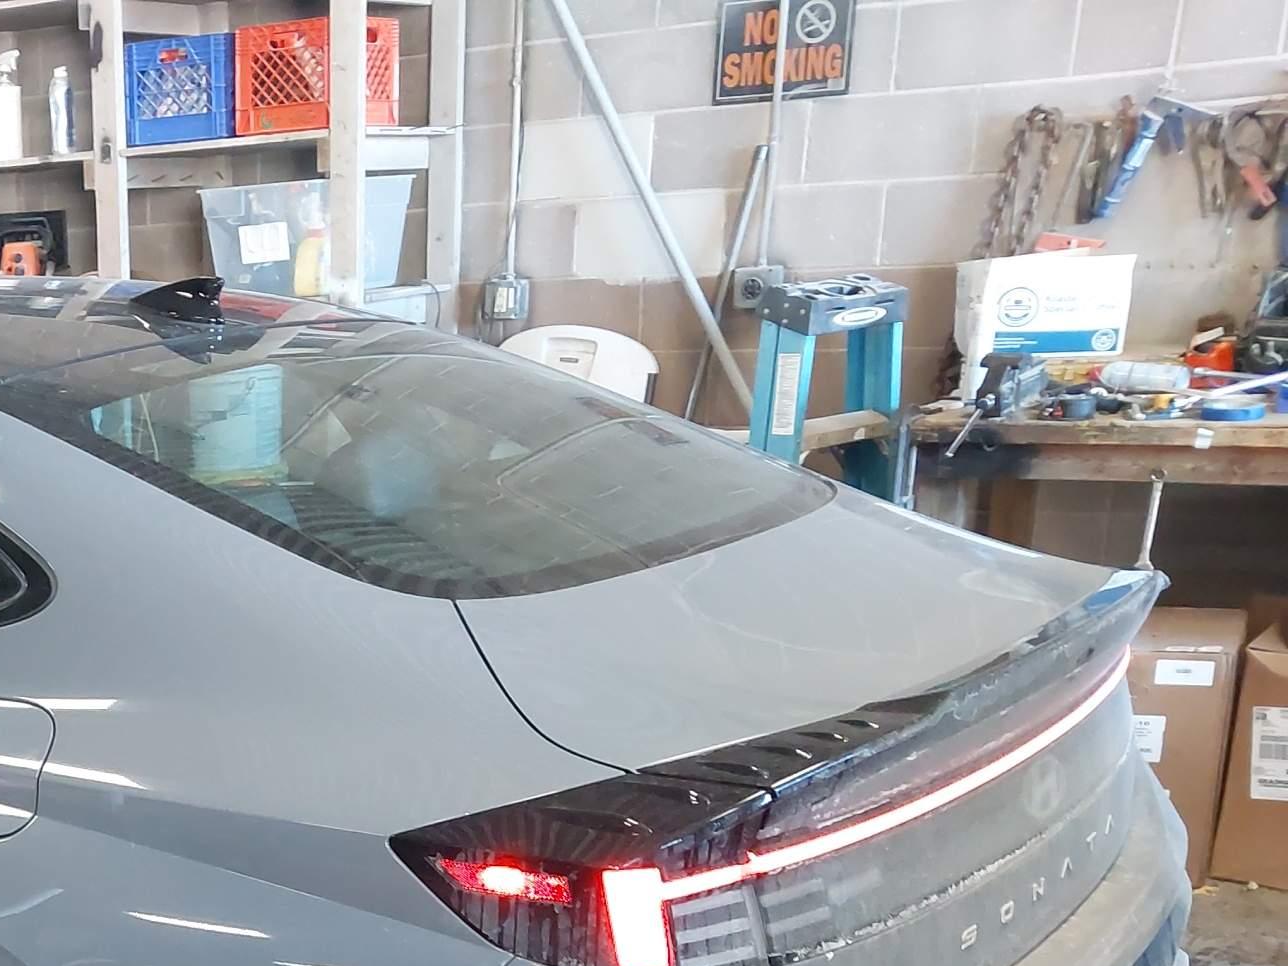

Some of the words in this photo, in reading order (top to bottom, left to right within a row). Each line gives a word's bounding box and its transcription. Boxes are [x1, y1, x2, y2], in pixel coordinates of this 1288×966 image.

[744, 9, 779, 46] NO
[723, 44, 842, 88] SMOKING
[961, 814, 1114, 950] SONATA
